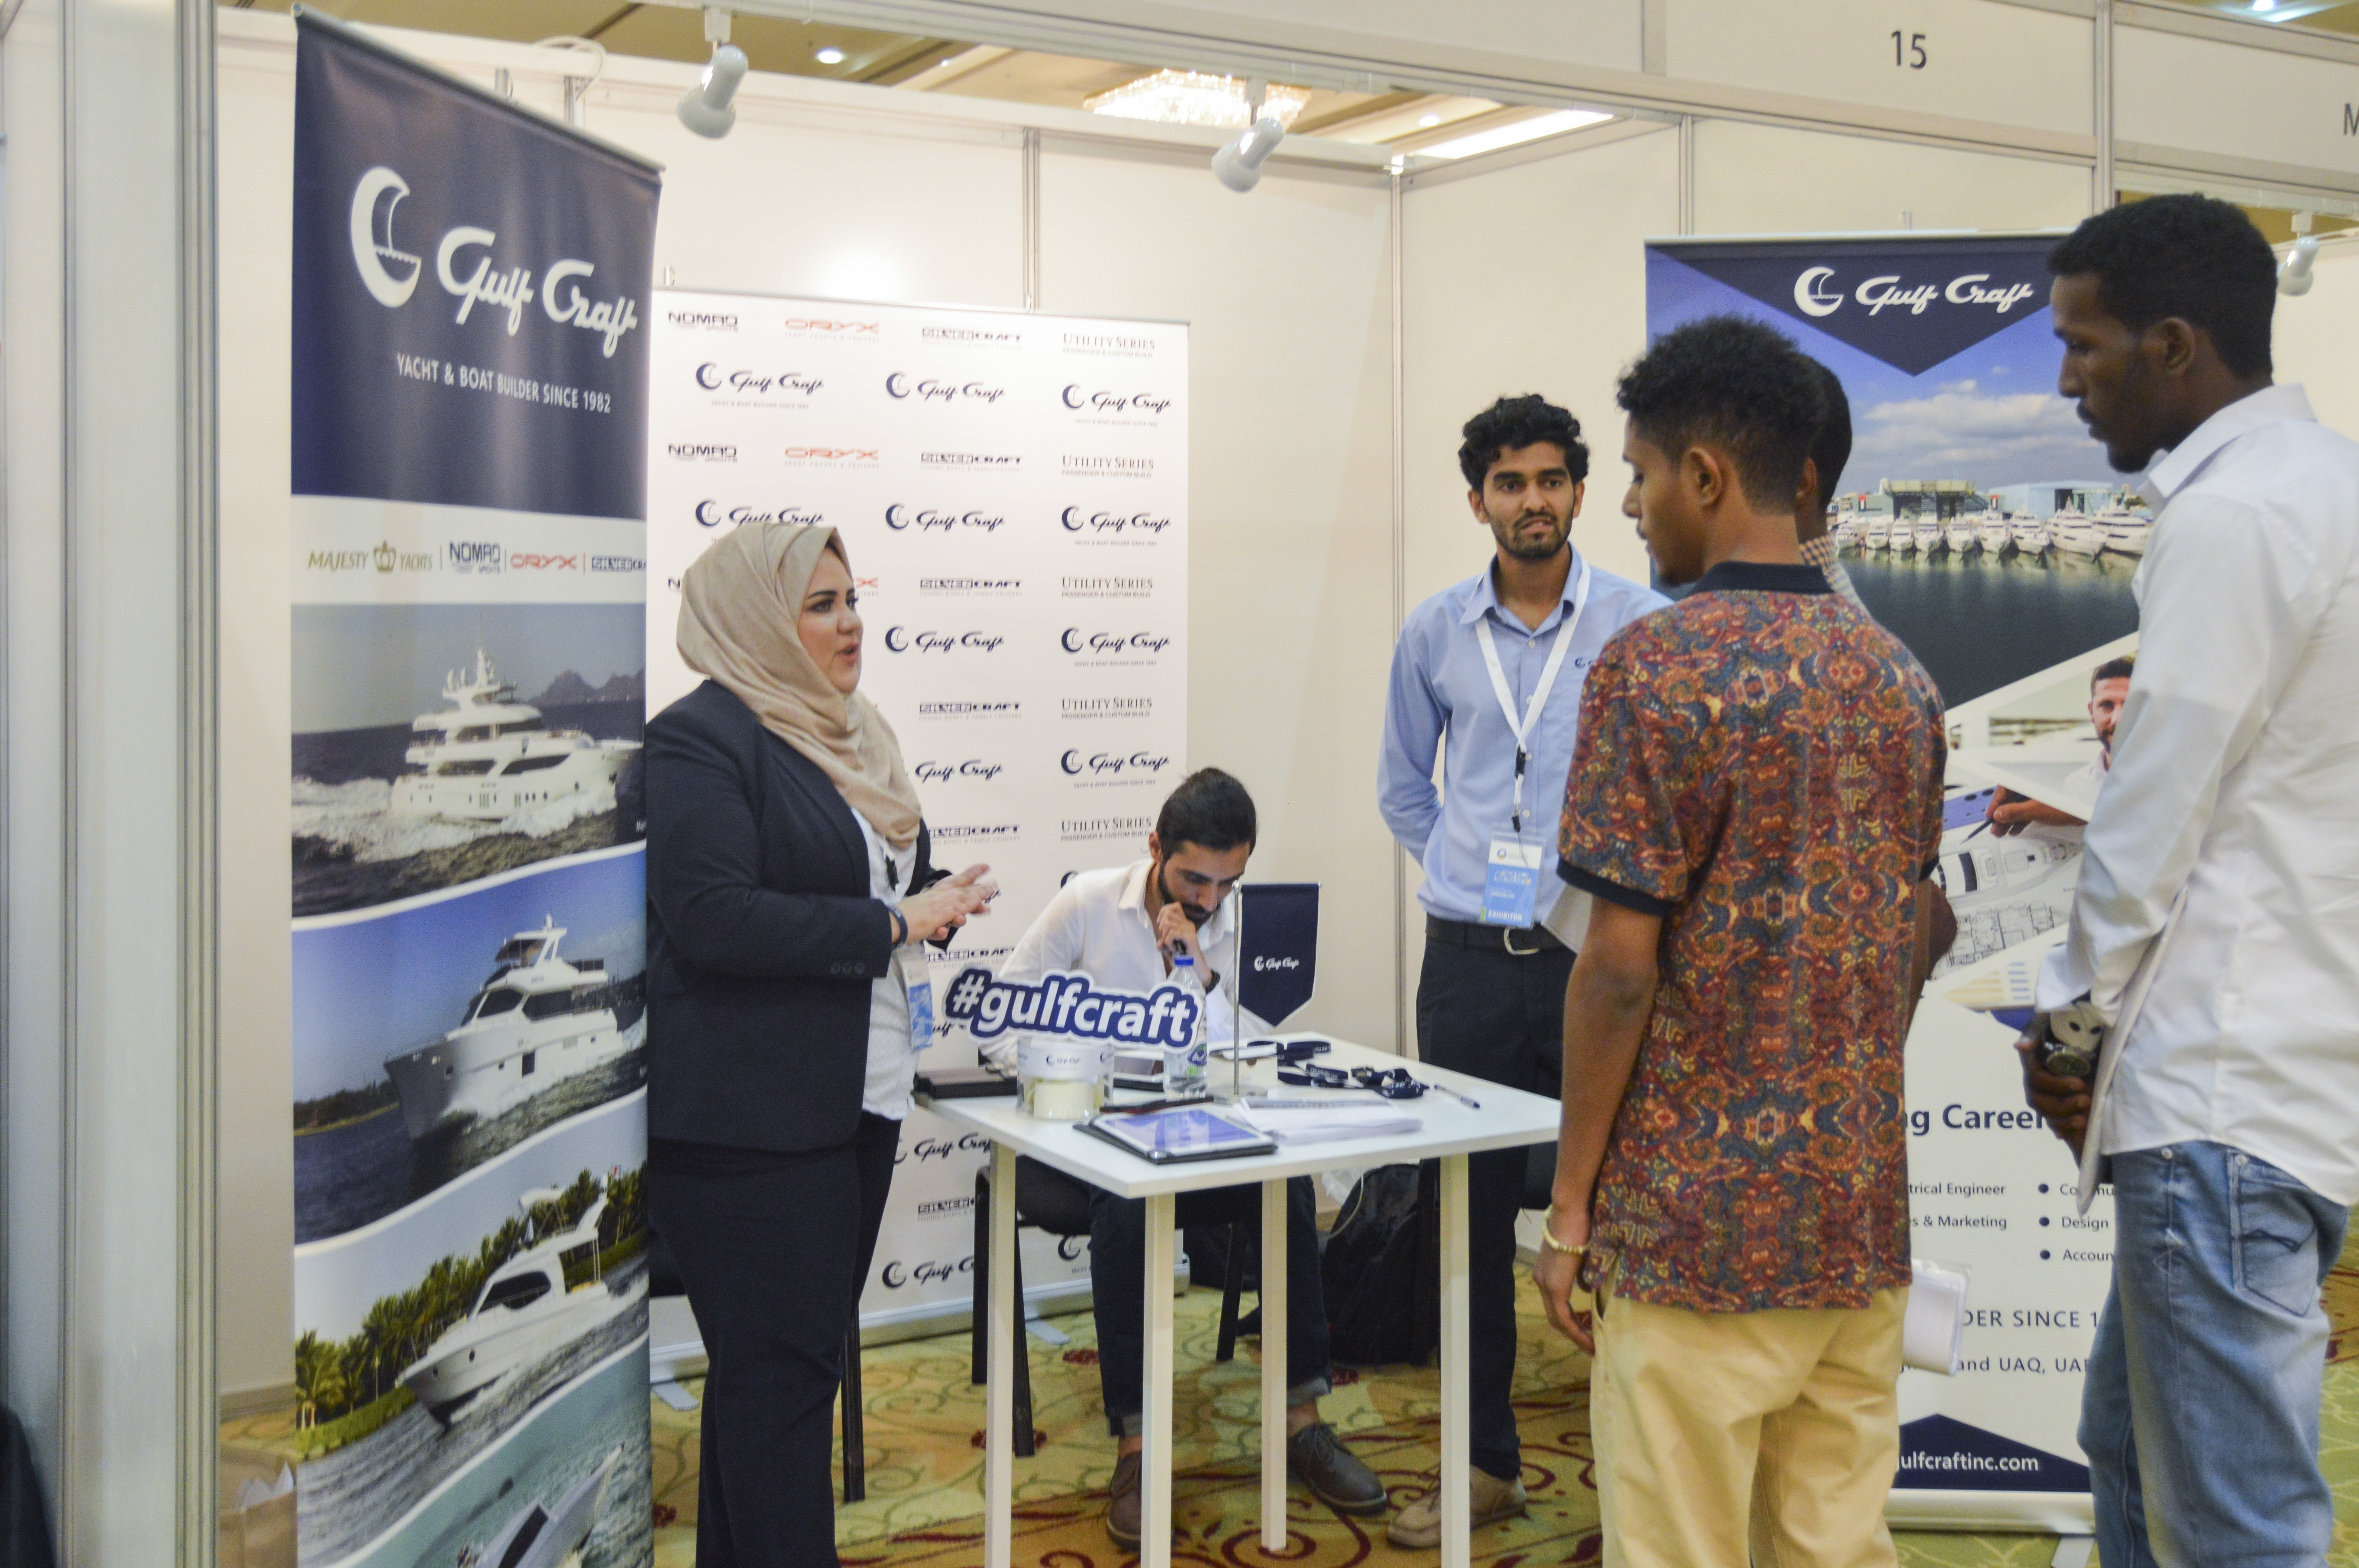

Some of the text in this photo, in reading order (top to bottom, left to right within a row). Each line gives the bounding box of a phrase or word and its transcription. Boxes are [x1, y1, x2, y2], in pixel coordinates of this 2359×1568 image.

[1891, 30, 1927, 70] 15
[437, 226, 637, 358] Gulf Craft
[1855, 274, 2034, 316] Gulf Craft
[668, 311, 738, 326] NOMAD
[785, 318, 879, 334] ORYX
[1063, 332, 1155, 350] UTILITY SERIES
[397, 353, 611, 413] YACHT & BOAT BUILDER SINCE 1982
[730, 369, 825, 396] Gulf Craft
[917, 379, 1005, 404] Gulf Craft
[1091, 391, 1171, 415] Gulf Craft
[668, 444, 737, 457] NOMAD
[785, 447, 879, 460] ORYX
[921, 451, 1023, 464] SILVERCRAFT
[1063, 454, 1154, 469] UTILITY SERIES
[916, 509, 1005, 533] Gulf Craft
[1090, 511, 1171, 534] Gulf Craft
[309, 551, 433, 573] MAJESTY YACHTS
[449, 541, 500, 564] NOMAD
[511, 553, 577, 570] ORYX
[920, 577, 1022, 590] SILVERCRAFT
[1062, 575, 1153, 589] UTILITY SERIES
[916, 630, 1004, 653] Gulf Craft
[1089, 631, 1170, 654] Gulf Craft
[920, 701, 1021, 714] SILVERCRAFT
[1062, 696, 1152, 711] UTILITY SERIES
[915, 759, 1003, 784] Gulf Craft
[1089, 750, 1170, 775] Gulf Craft
[1061, 816, 1151, 833] UTILITY SERIES
[1488, 909, 1522, 921] EXHIBITOR
[952, 974, 1190, 1042] #gulfcraft
[914, 1138, 954, 1162] Gulf
[1947, 1183, 2006, 1197] Engineer
[1923, 1216, 1933, 1227] &
[1938, 1216, 2007, 1231] Marketing
[2061, 1217, 2109, 1232] Design
[914, 1260, 954, 1285] Gulf
[2013, 1311, 2080, 1328] SINCE
[1999, 1357, 2046, 1374] UAQ,
[1897, 1451, 2039, 1472] ulfcraftinc.com
